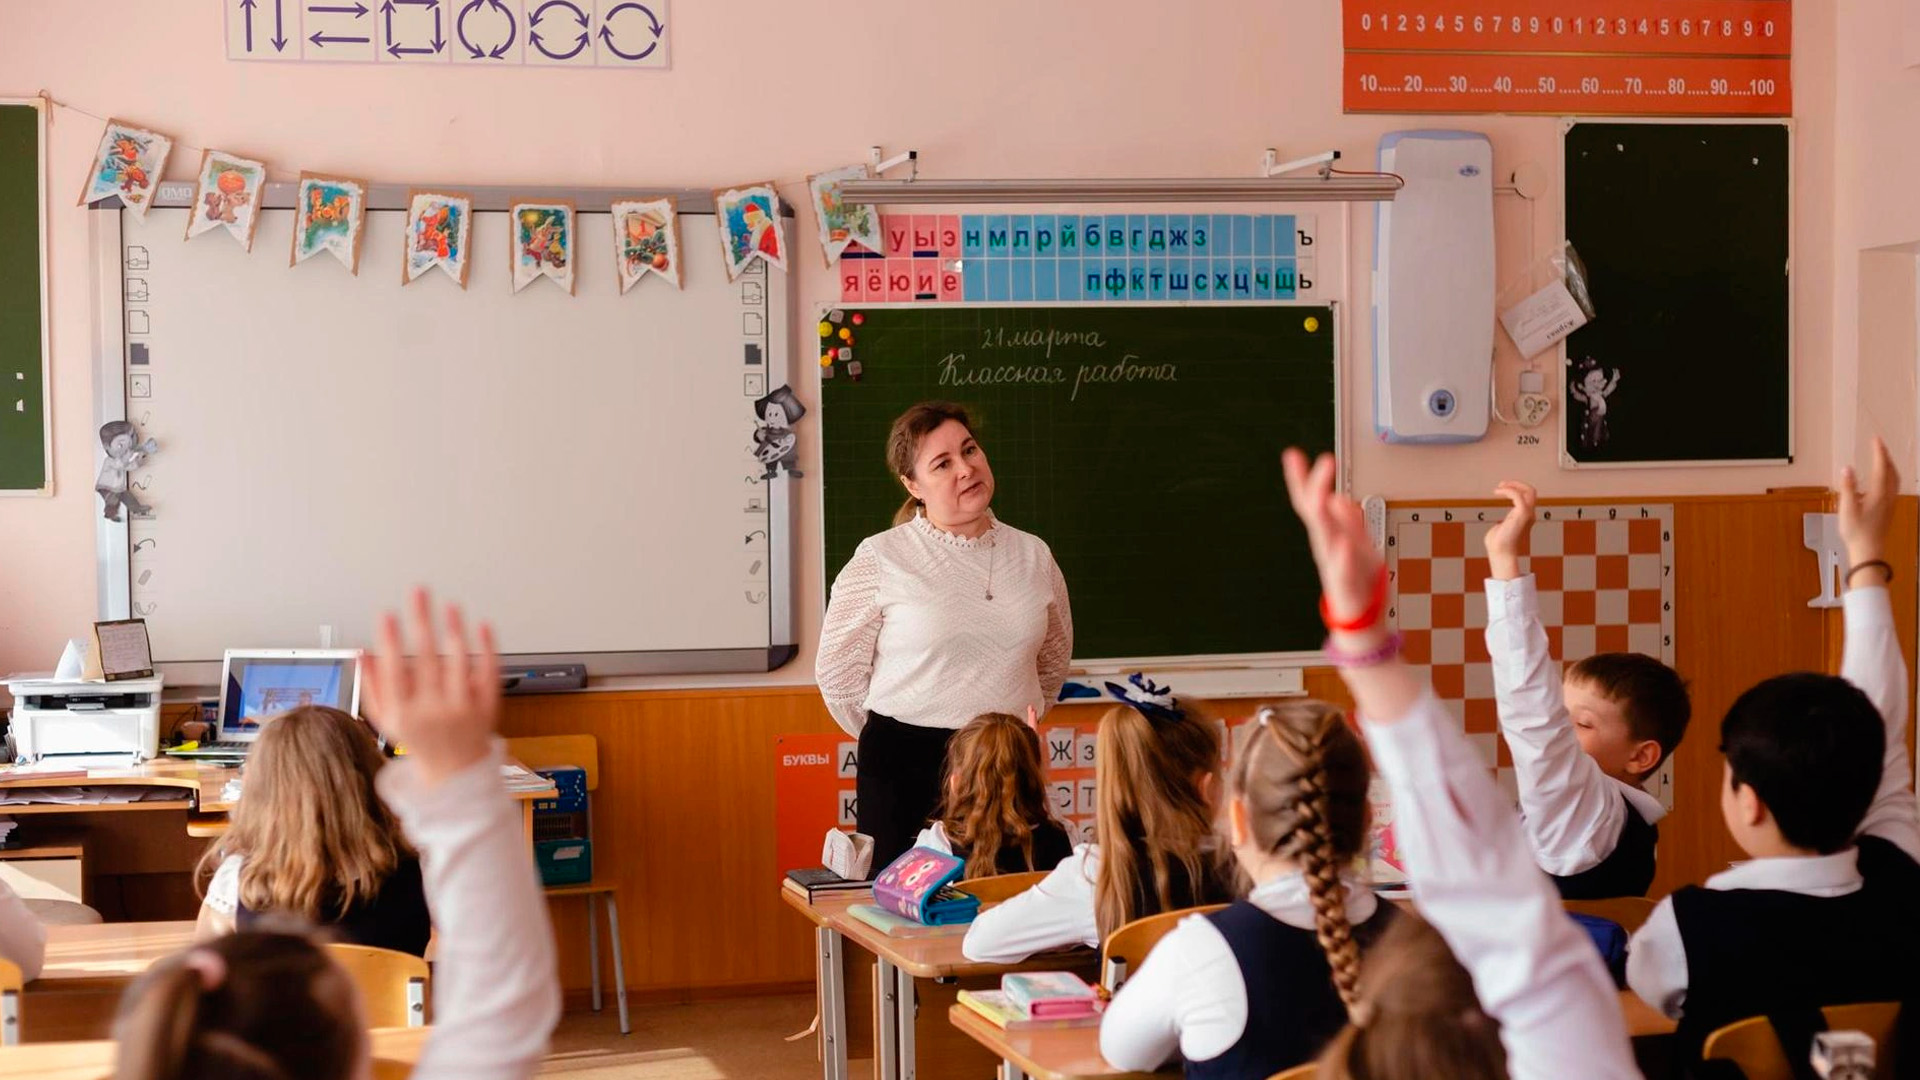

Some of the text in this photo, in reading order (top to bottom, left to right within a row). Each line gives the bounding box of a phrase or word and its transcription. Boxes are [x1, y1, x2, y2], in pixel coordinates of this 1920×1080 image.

[1361, 14, 1371, 31] 0
[1381, 14, 1389, 31] 1
[1398, 15, 1408, 31] 2
[1417, 15, 1426, 32] 3
[1435, 15, 1445, 32] 4
[1455, 15, 1464, 32] 5
[1474, 16, 1483, 32] 6
[1493, 16, 1502, 33] 7
[1512, 17, 1521, 33] 8
[1530, 17, 1539, 33] 9
[981, 327, 1107, 359] 21 марта
[938, 352, 1178, 402] Классная работа
[1411, 507, 1649, 522] a b c e f g h
[1388, 535, 1396, 547] 8
[1662, 531, 1671, 542] 8
[1388, 571, 1396, 582] 7
[1662, 566, 1671, 577] 7
[1388, 607, 1396, 618] 6
[1663, 601, 1671, 612] 6
[1662, 635, 1671, 646] 5
[1050, 740, 1072, 761] Ж
[783, 753, 830, 767] БУКВЫ
[1662, 773, 1669, 785] 1
